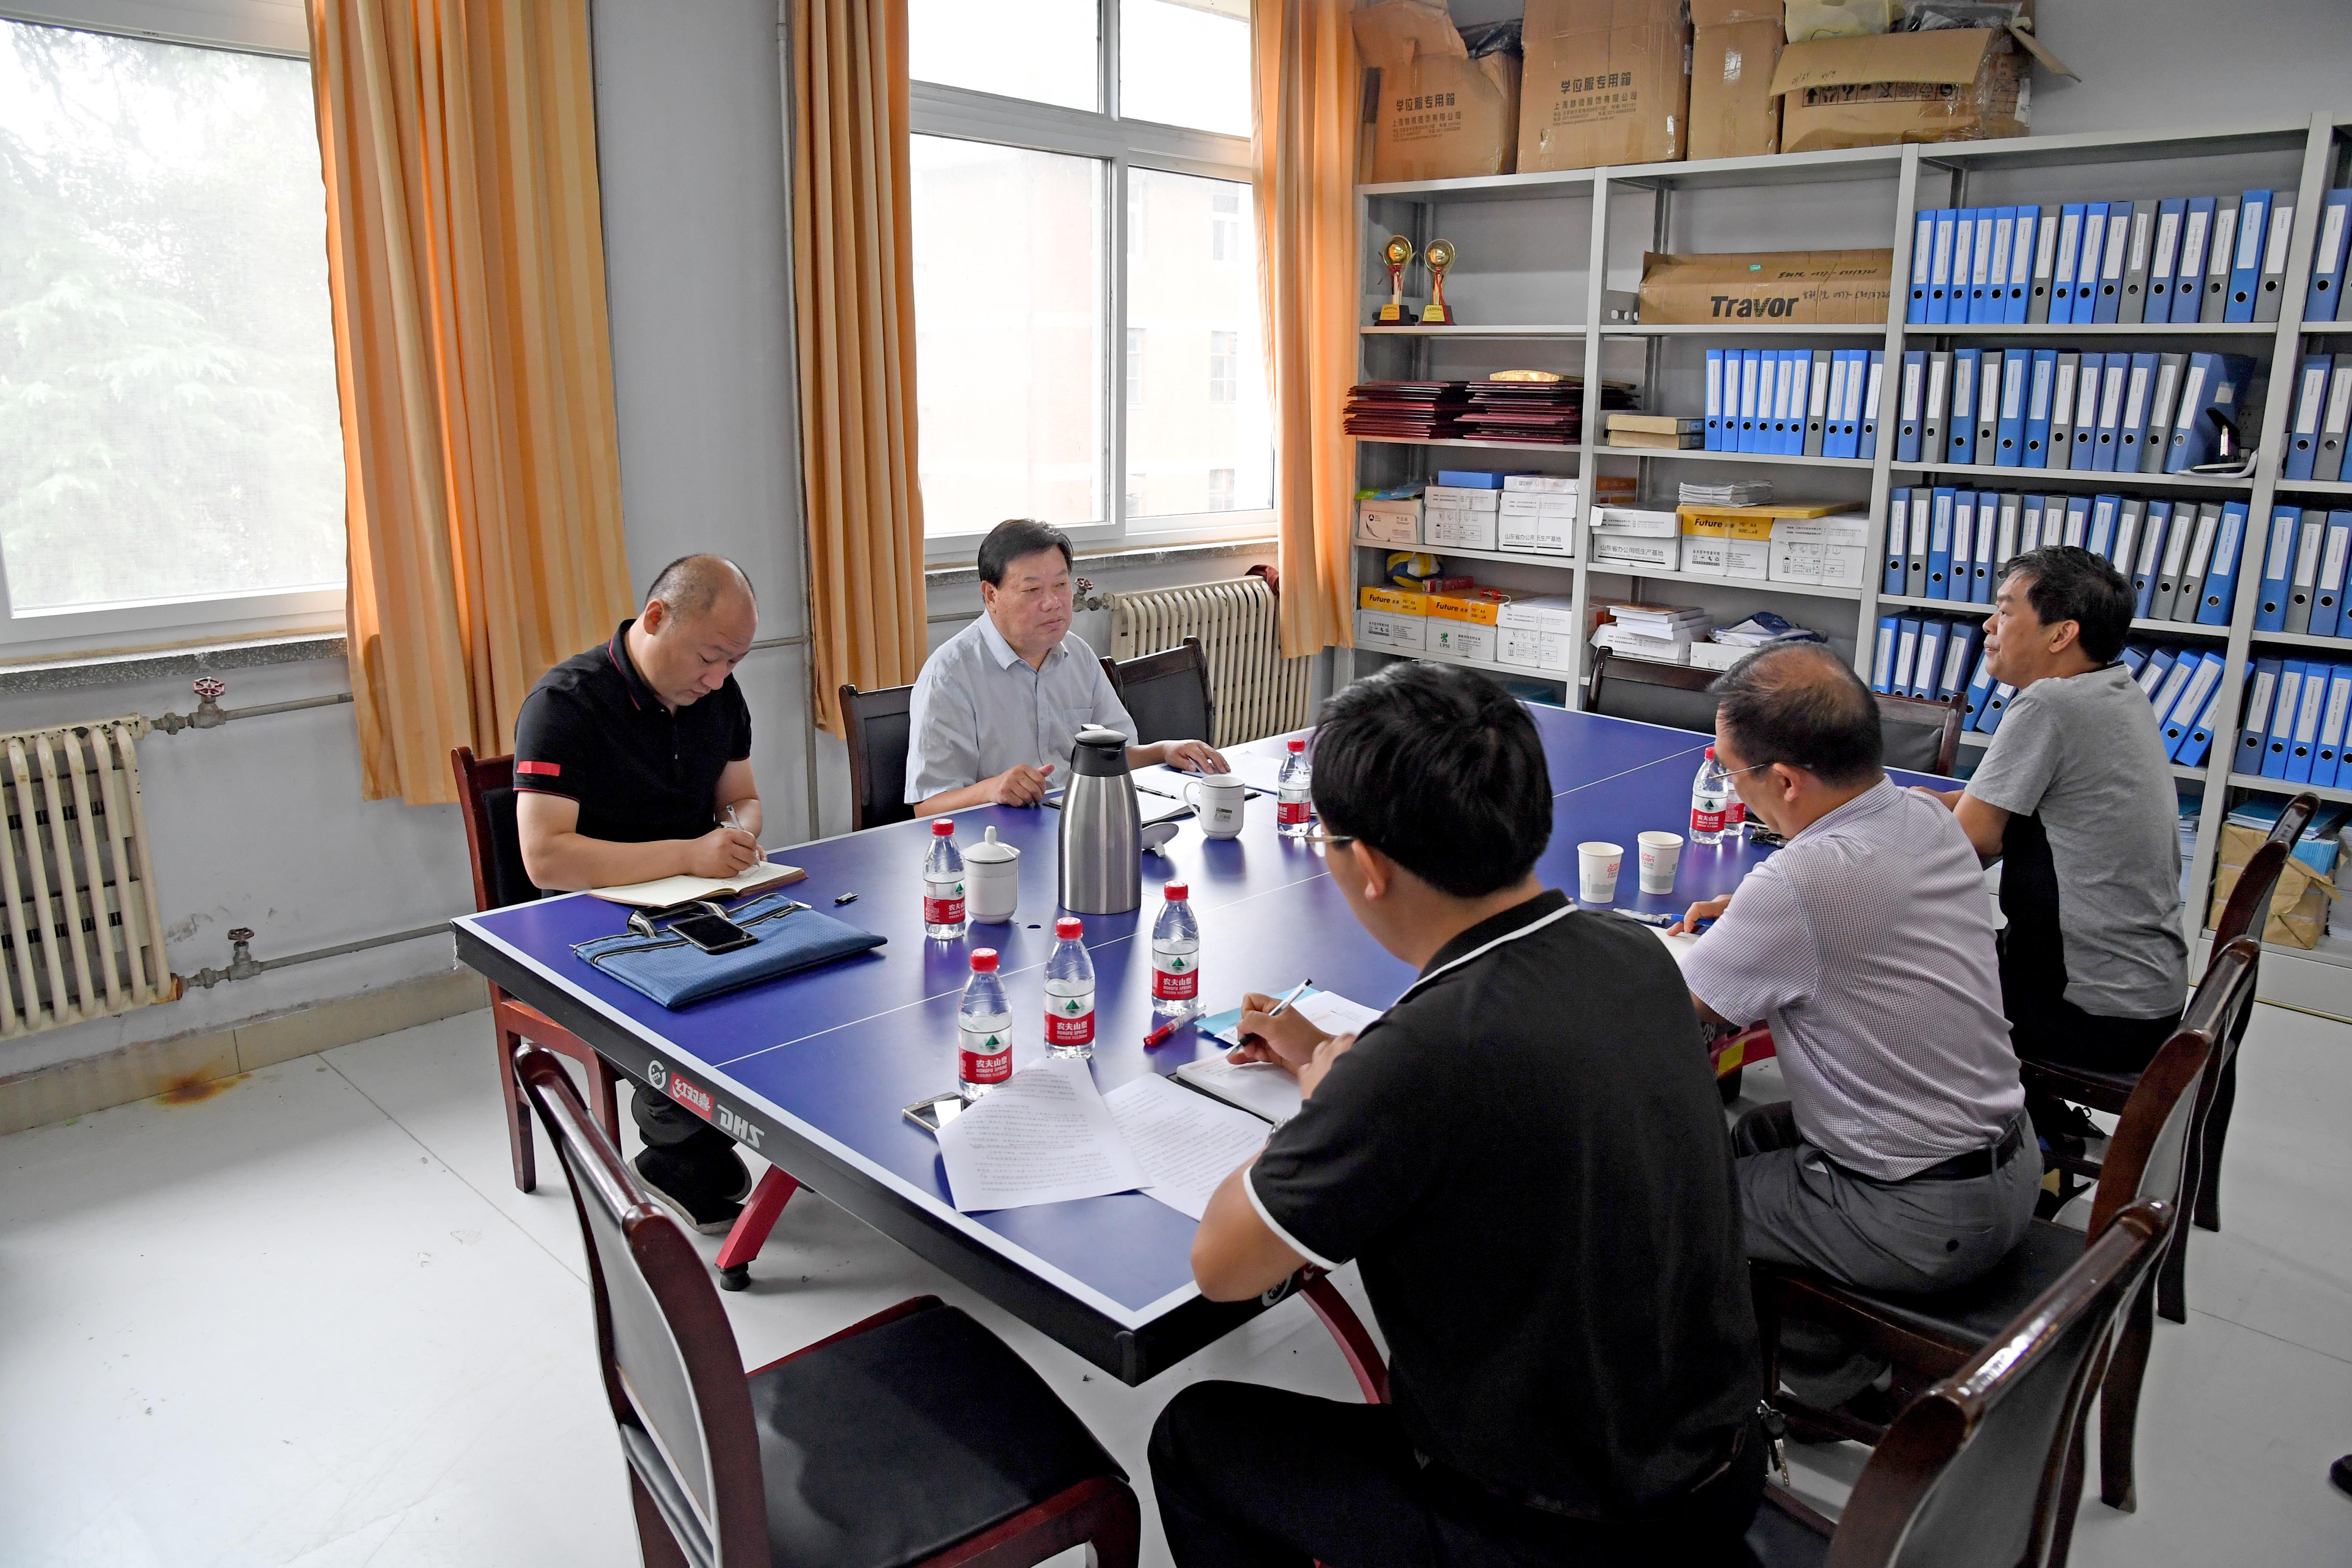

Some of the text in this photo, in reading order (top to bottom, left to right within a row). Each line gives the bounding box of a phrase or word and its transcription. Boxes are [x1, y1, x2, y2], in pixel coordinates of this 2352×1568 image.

[1561, 72, 1631, 94] 学位服专用箱
[1396, 93, 1455, 112] 学位服专用箱
[1711, 296, 1799, 317] Travor
[1695, 518, 1723, 528] Future
[1600, 544, 1663, 557] 山东省办公用纸生产基地
[1369, 594, 1391, 604] Future
[1436, 602, 1459, 612] Future
[949, 901, 965, 911] 农夫山
[1163, 977, 1192, 986] 农夫山泉
[1056, 1020, 1088, 1030] 农夫山泉
[976, 1056, 1007, 1068] 农夫山泉
[672, 1078, 711, 1112] 红双喜
[716, 1104, 765, 1149] DHS
